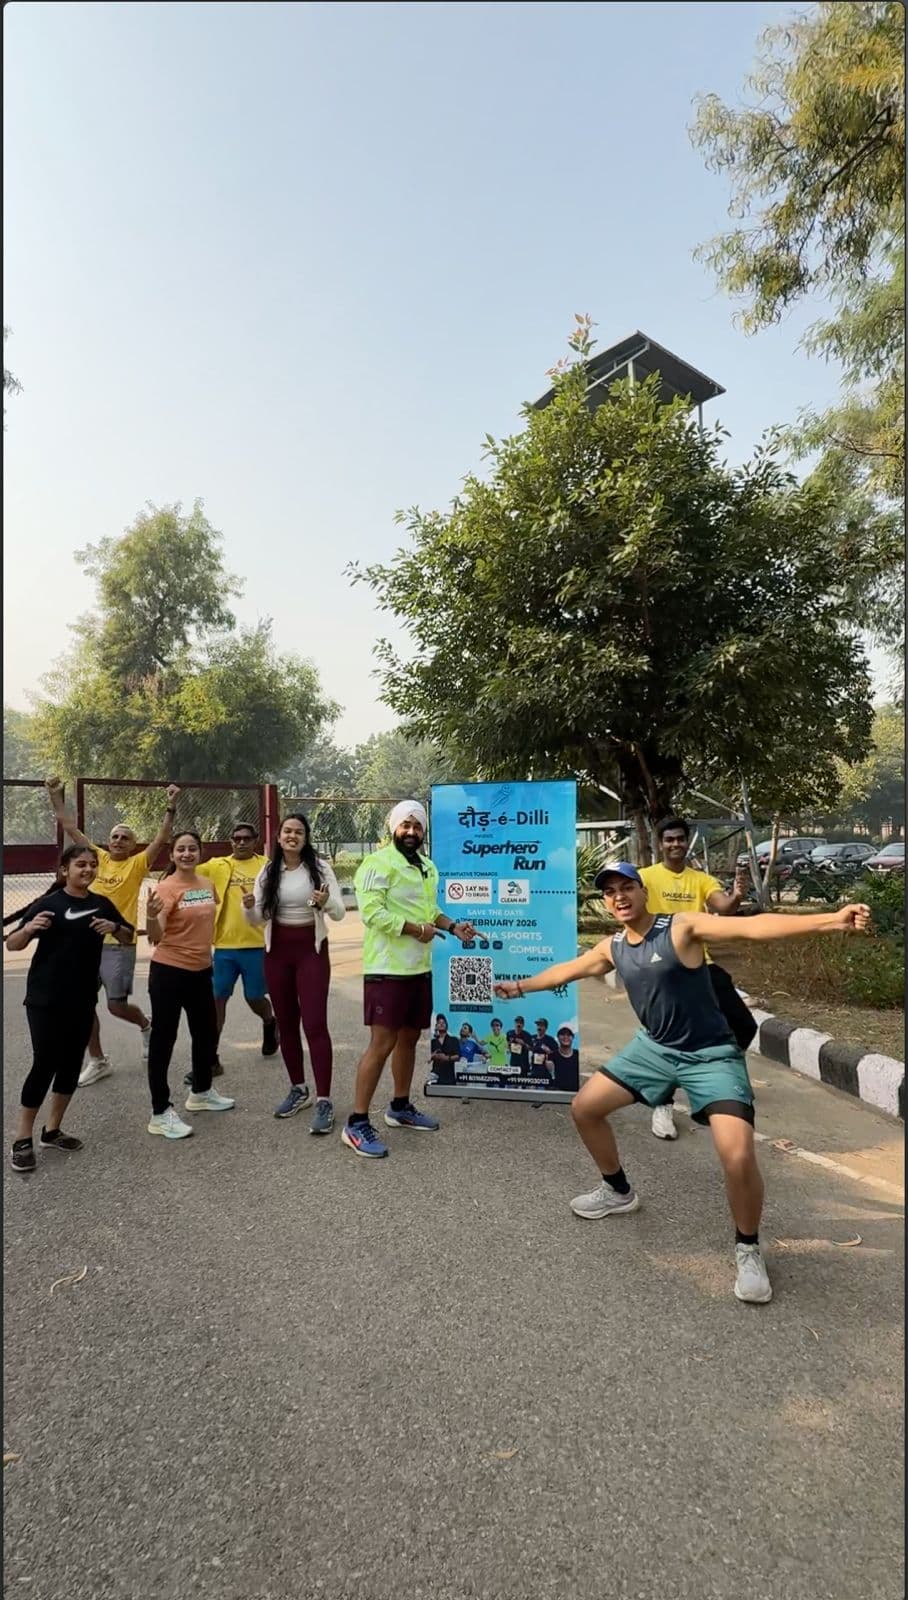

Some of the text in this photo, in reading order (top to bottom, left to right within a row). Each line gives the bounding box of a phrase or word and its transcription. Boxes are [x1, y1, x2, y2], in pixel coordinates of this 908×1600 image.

[462, 840, 539, 858] Superhero
[513, 856, 546, 871] Run
[467, 908, 486, 916] SAVE
[516, 919, 537, 927] 2026
[501, 931, 543, 941] SPORTS
[508, 945, 554, 954] COMPLEX
[494, 973, 511, 981] WIN
